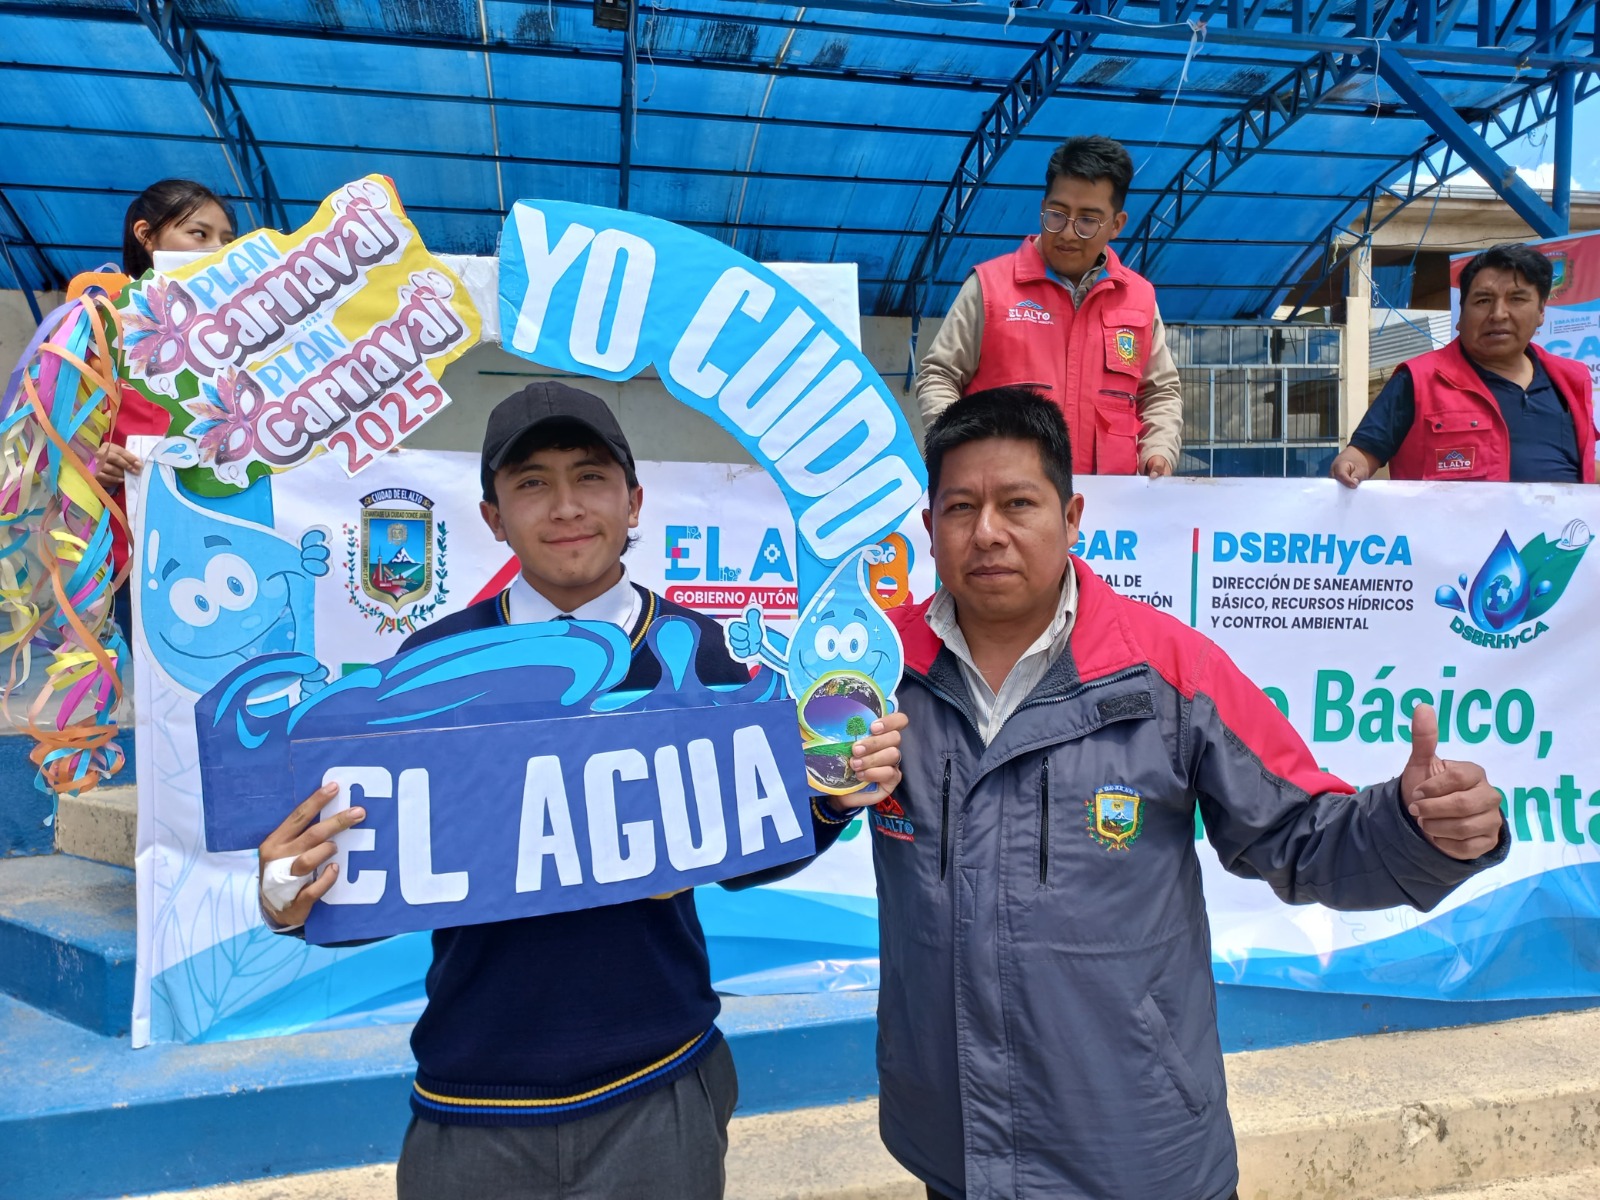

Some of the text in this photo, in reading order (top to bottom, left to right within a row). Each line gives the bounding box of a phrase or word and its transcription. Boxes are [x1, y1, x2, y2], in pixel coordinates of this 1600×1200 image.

[186, 197, 400, 377] Carnaval
[187, 239, 282, 309] PLAN
[1008, 308, 1022, 318] EL
[1023, 309, 1051, 321] ALTO
[252, 286, 466, 466] Carnaval
[255, 321, 348, 398] PLAN
[511, 200, 923, 560] YO CUIDO
[328, 369, 443, 474] 2025
[1450, 460, 1471, 468] ALTO
[371, 489, 423, 504] CIUDAD DE EL ALTO
[665, 525, 741, 581] EL
[1068, 530, 1138, 560] GAR
[1212, 531, 1413, 575] DSBRHyCA
[673, 589, 798, 605] GOBIERNO AUTÓN
[1124, 575, 1142, 588] DE
[1212, 574, 1413, 592] DIRECCIÓN DE SANEAMIENTO
[1211, 593, 1414, 611] BÁSICO, RECURSOS HÍDRICOS
[1211, 615, 1369, 630] Y CONTROL AMBIENTAL
[1449, 615, 1550, 650] DSBRHyCA
[1312, 666, 1554, 759] Básico,
[319, 724, 803, 905] EL AGUA
